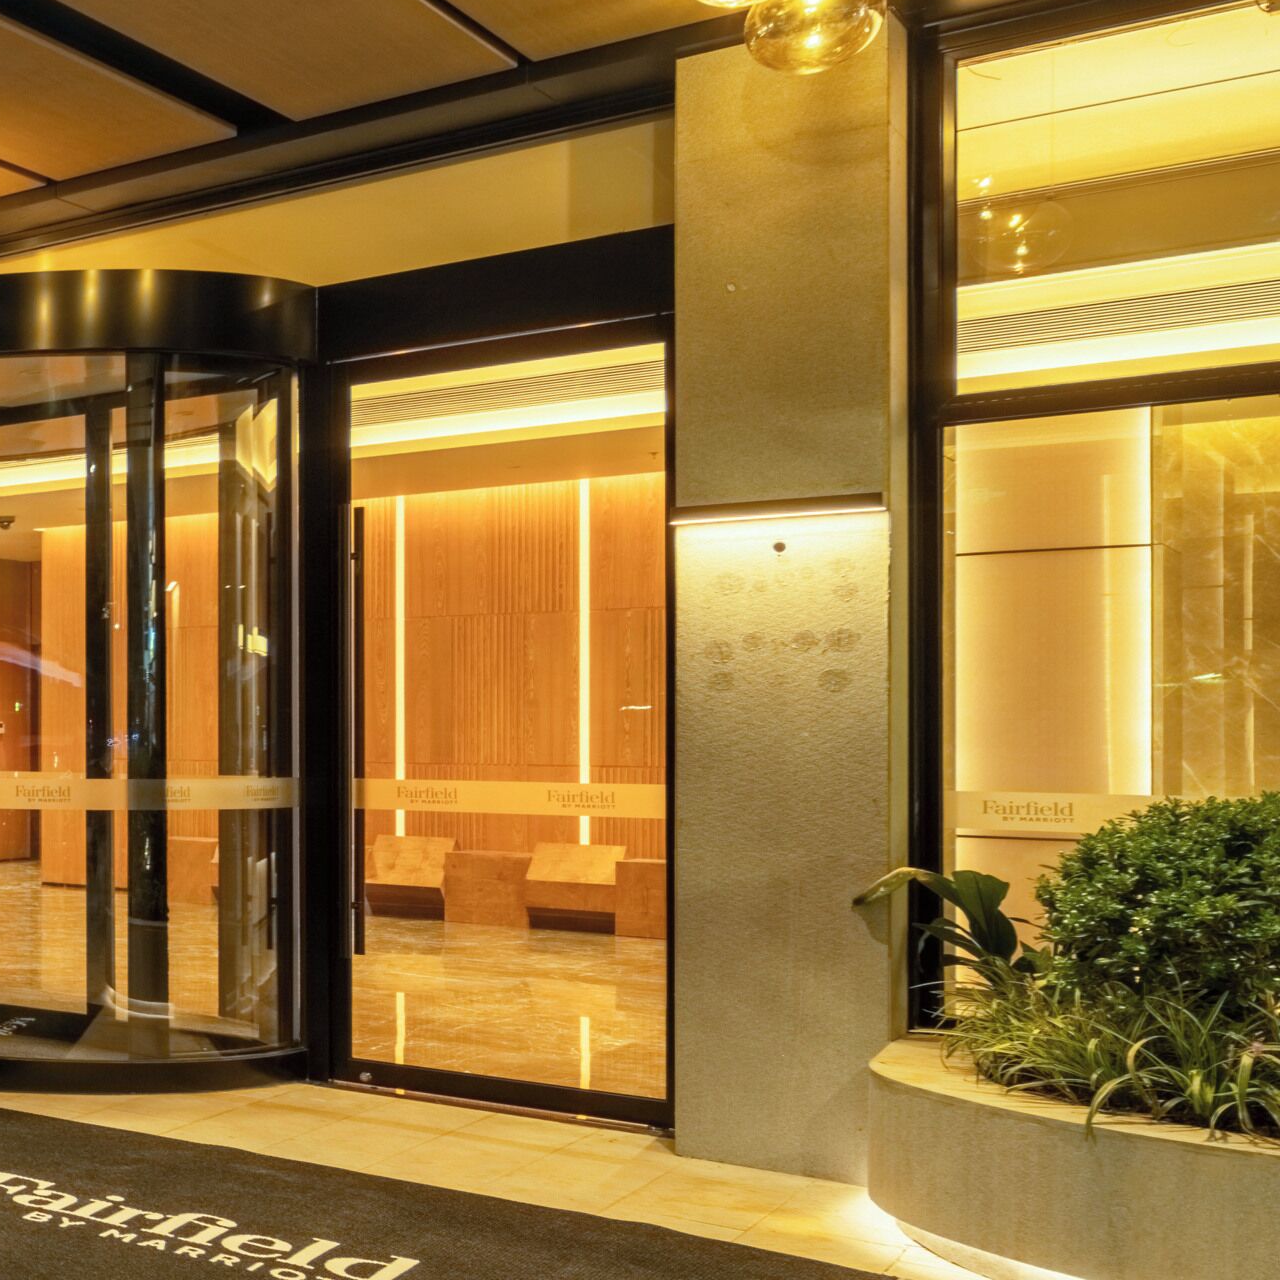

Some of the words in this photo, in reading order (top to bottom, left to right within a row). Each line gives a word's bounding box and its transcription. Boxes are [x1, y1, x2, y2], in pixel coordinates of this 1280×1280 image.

[15, 785, 71, 798] Fairfield
[397, 786, 457, 799] Fairfield
[547, 790, 616, 804] Fairfield
[982, 800, 1074, 817] Fairfield
[22, 1211, 86, 1228] BY
[99, 1228, 333, 1280] MARRIO
